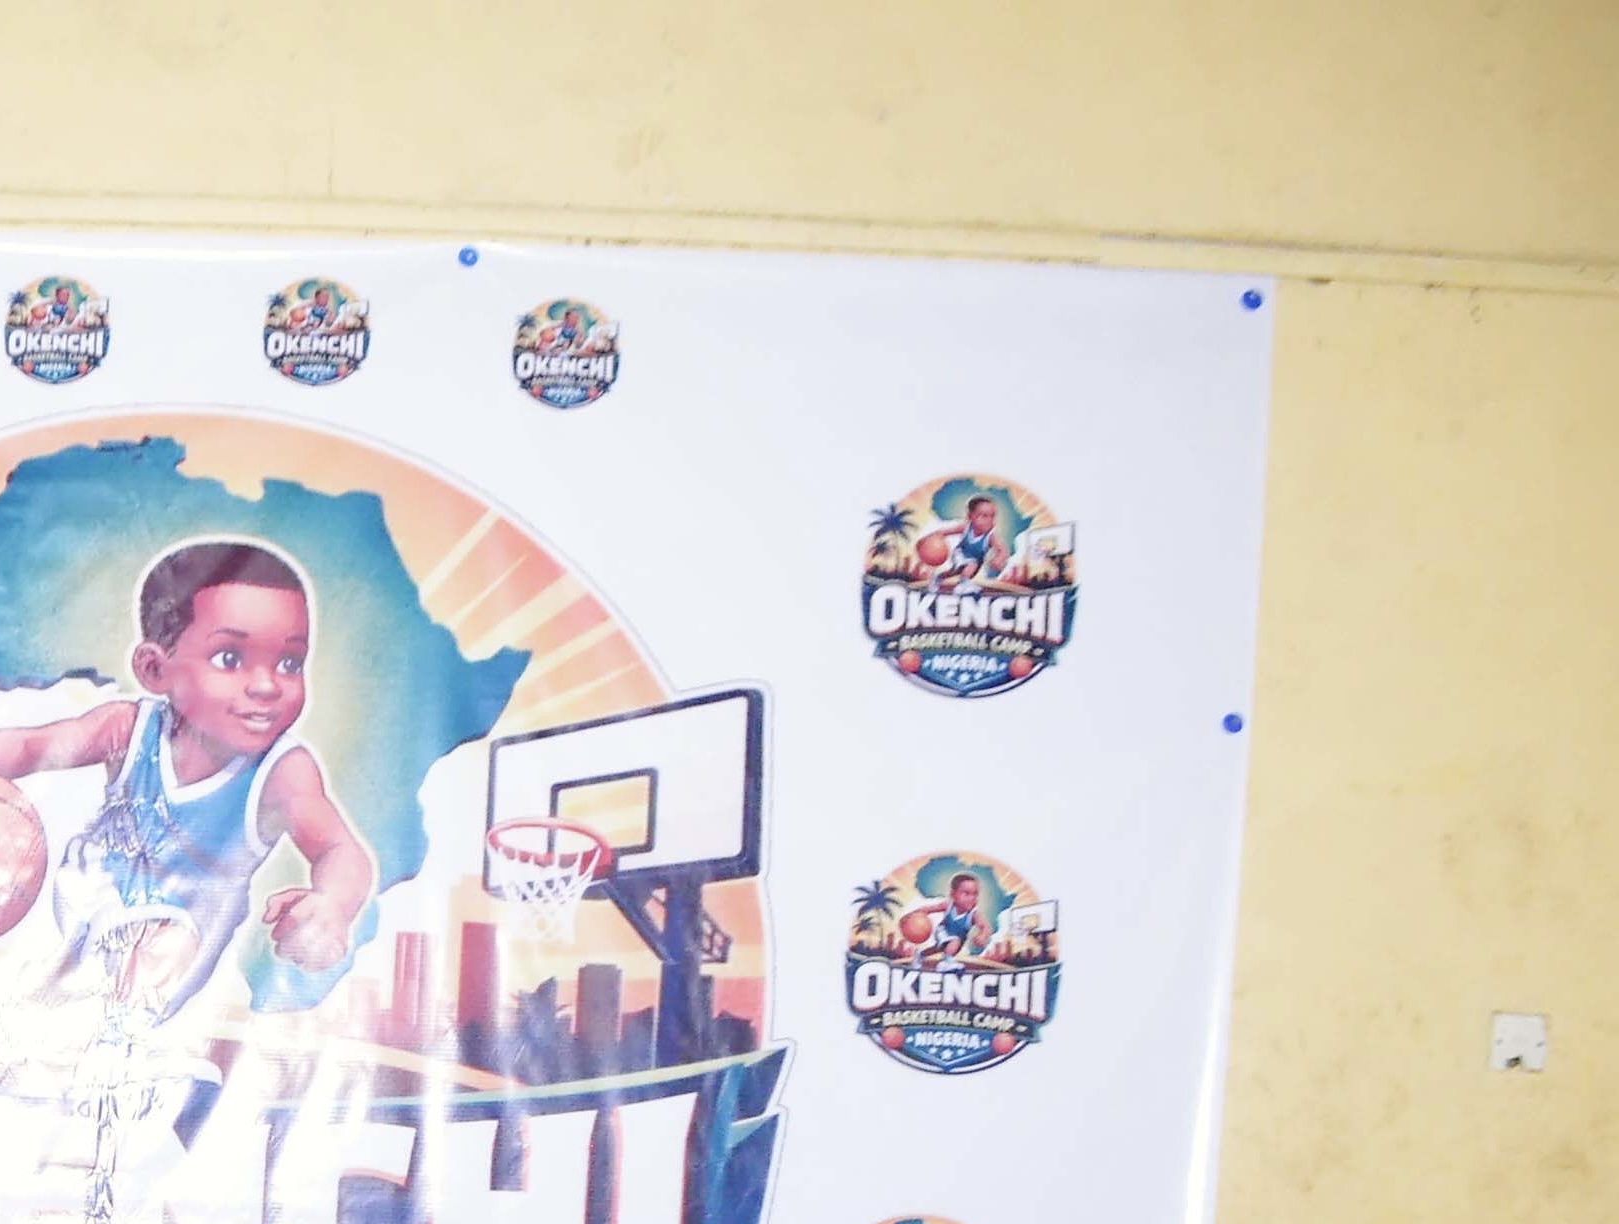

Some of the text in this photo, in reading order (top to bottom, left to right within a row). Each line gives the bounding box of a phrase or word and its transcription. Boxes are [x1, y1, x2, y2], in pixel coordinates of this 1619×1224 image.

[9, 330, 104, 357] OKENCHI
[267, 332, 364, 359] OKENCHI
[516, 353, 614, 381] OKENCHI
[869, 586, 1063, 644] OKENCHI
[853, 962, 1047, 1020] OKENCHI
[883, 1010, 1015, 1032] BASKETBALL CAMP
[915, 1032, 981, 1049] NIGERIA
